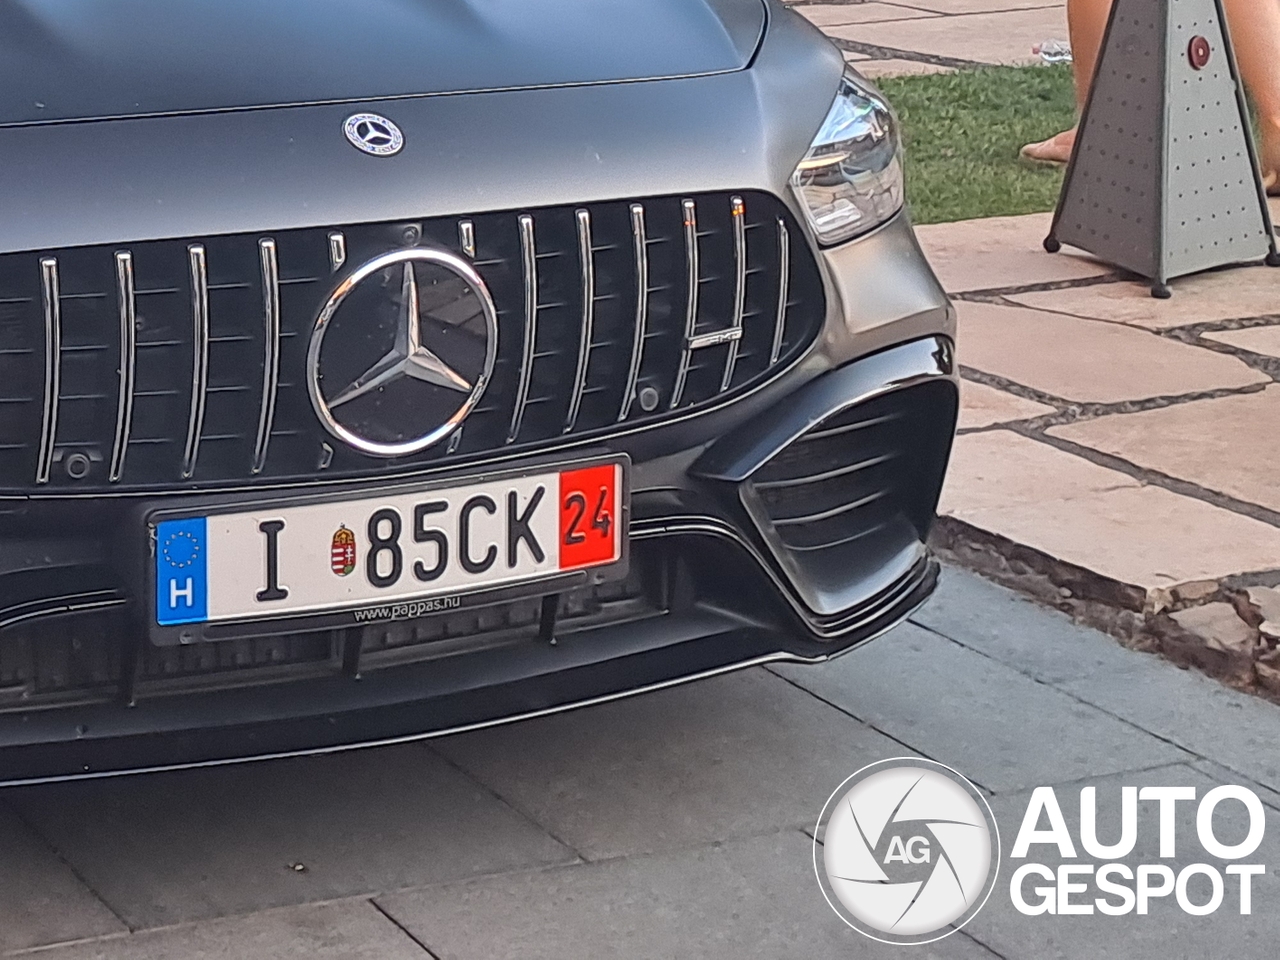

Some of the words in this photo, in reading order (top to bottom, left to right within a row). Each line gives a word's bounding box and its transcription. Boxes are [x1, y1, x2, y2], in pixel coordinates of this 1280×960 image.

[256, 519, 289, 602] I
[367, 486, 546, 588] 85CK
[563, 486, 612, 545] 24
[169, 577, 194, 609] H
[354, 596, 461, 622] www.pappas.hu
